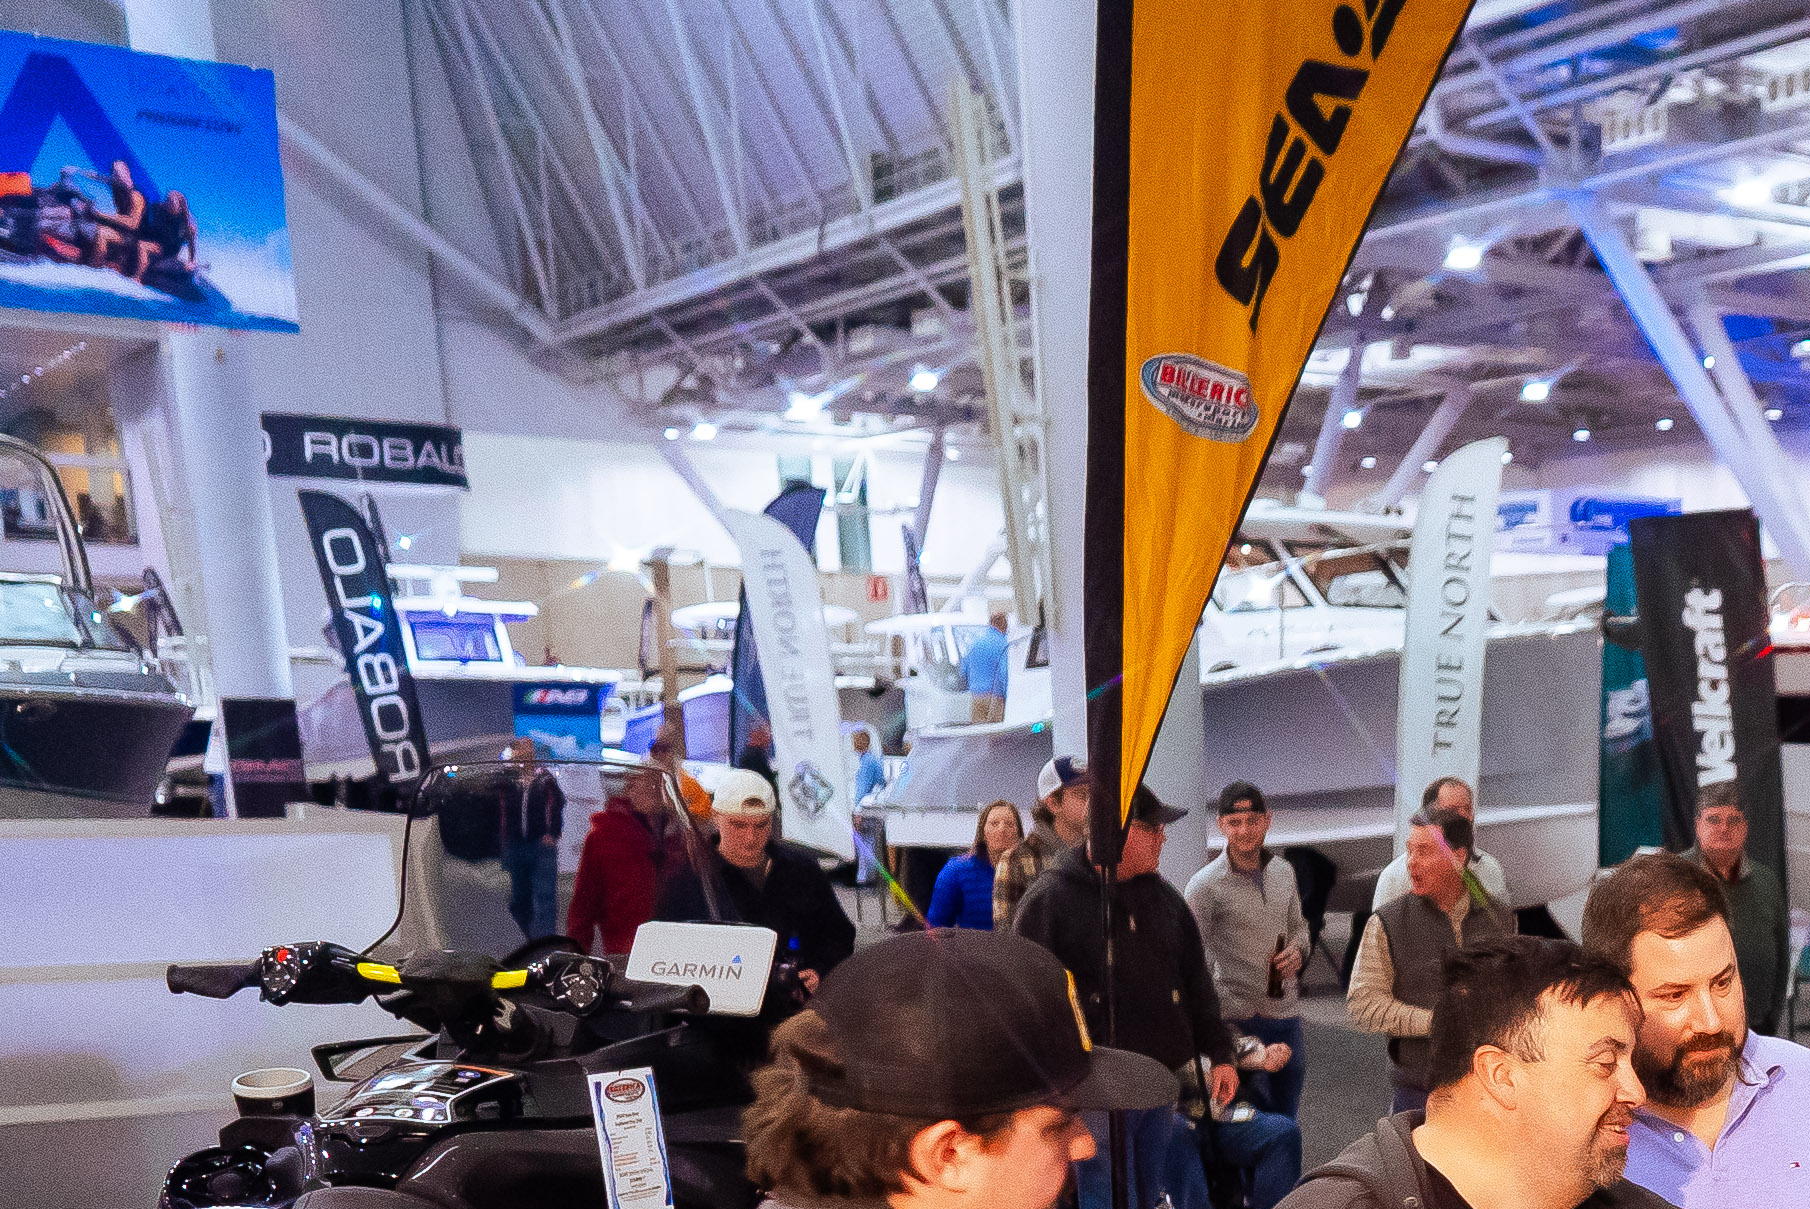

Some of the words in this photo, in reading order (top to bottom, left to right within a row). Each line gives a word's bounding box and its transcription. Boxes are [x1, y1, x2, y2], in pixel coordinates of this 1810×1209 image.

[1440, 492, 1476, 641] NORTH
[1433, 655, 1464, 757] TRUE
[650, 960, 743, 981] GARMIN
